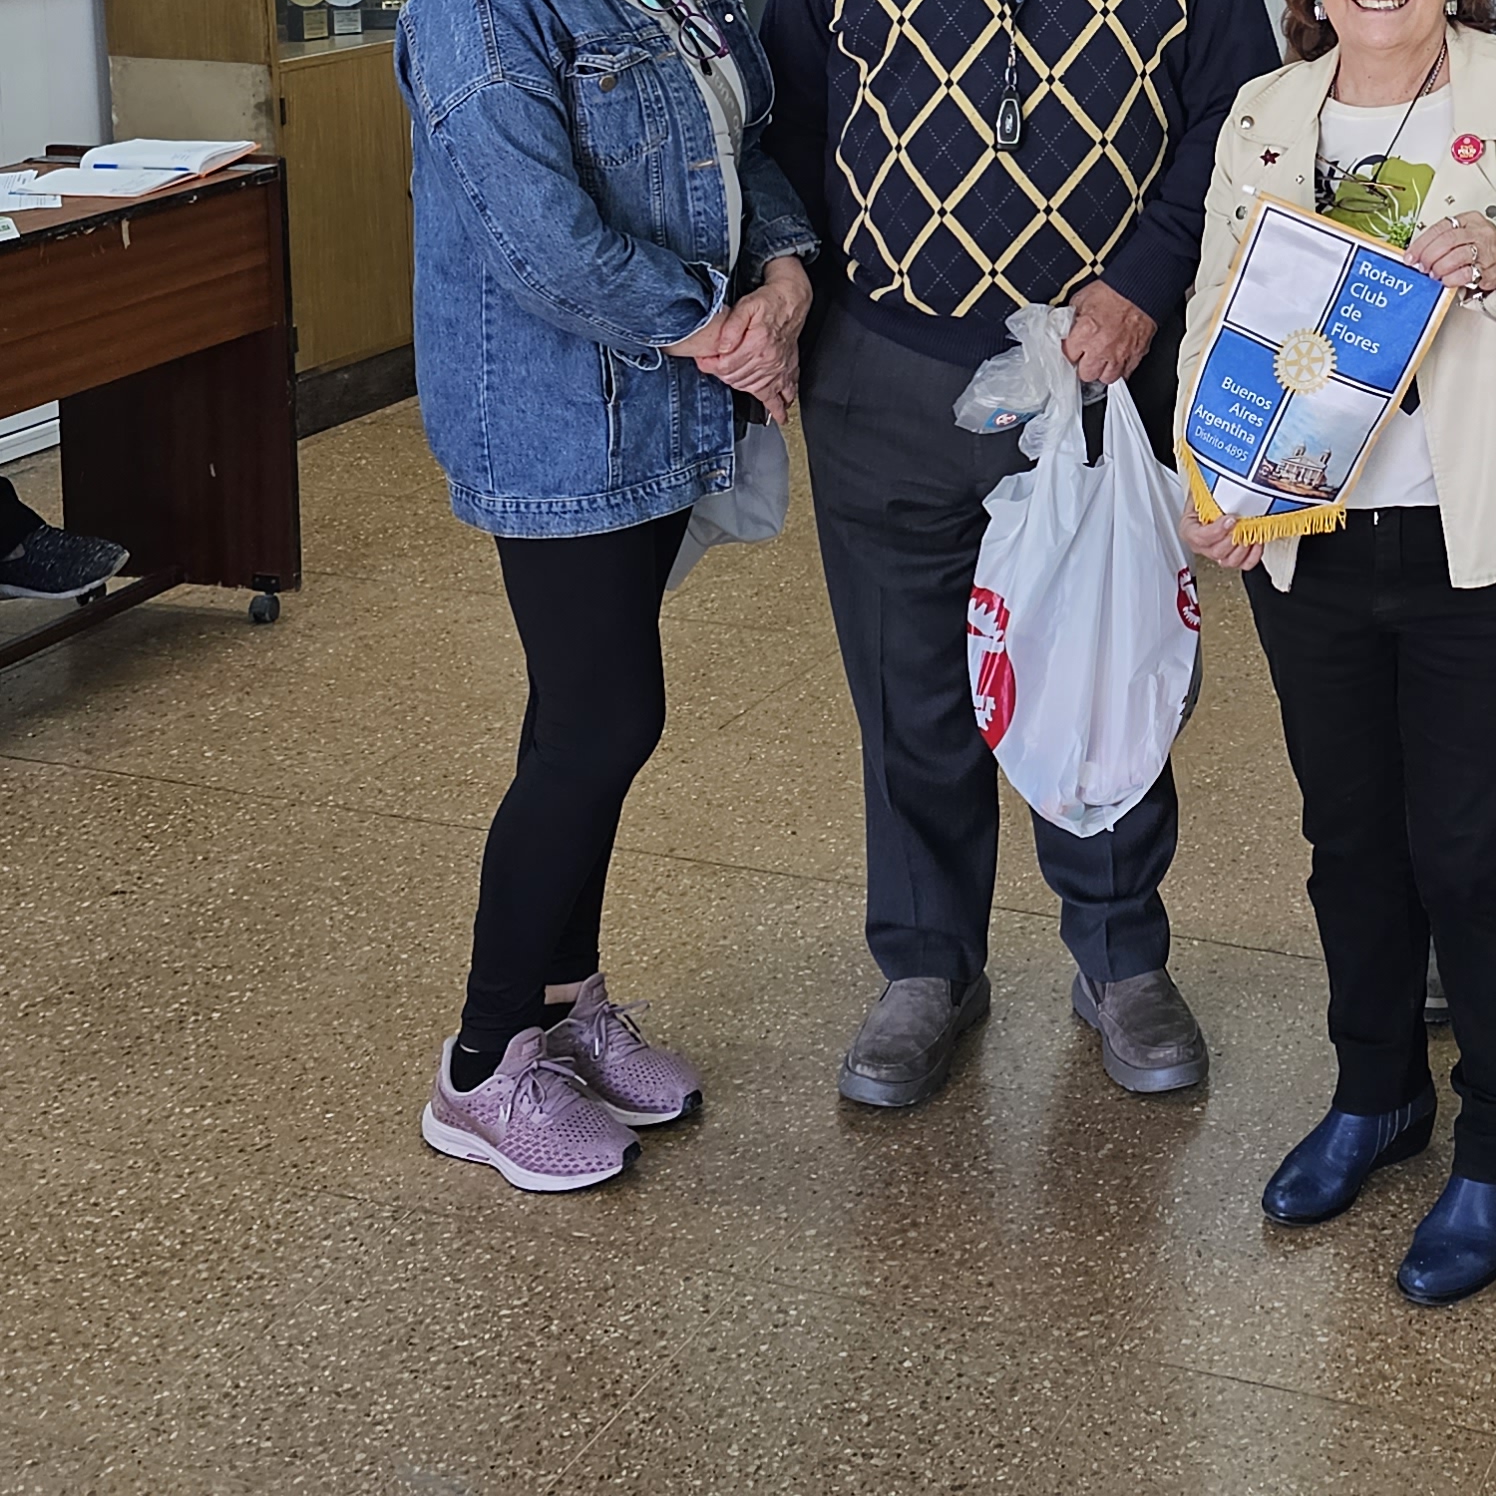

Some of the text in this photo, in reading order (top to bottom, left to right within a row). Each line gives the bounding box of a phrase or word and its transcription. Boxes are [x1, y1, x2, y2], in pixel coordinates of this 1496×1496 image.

[1358, 260, 1413, 296] Rotary
[1350, 282, 1388, 308] Club
[1340, 303, 1362, 322] de
[1330, 322, 1380, 354] Flores
[1221, 376, 1273, 410] Buenos
[1194, 404, 1256, 444] Argentina
[1228, 402, 1264, 428] Aires
[1194, 425, 1250, 462] Distrito 4895
